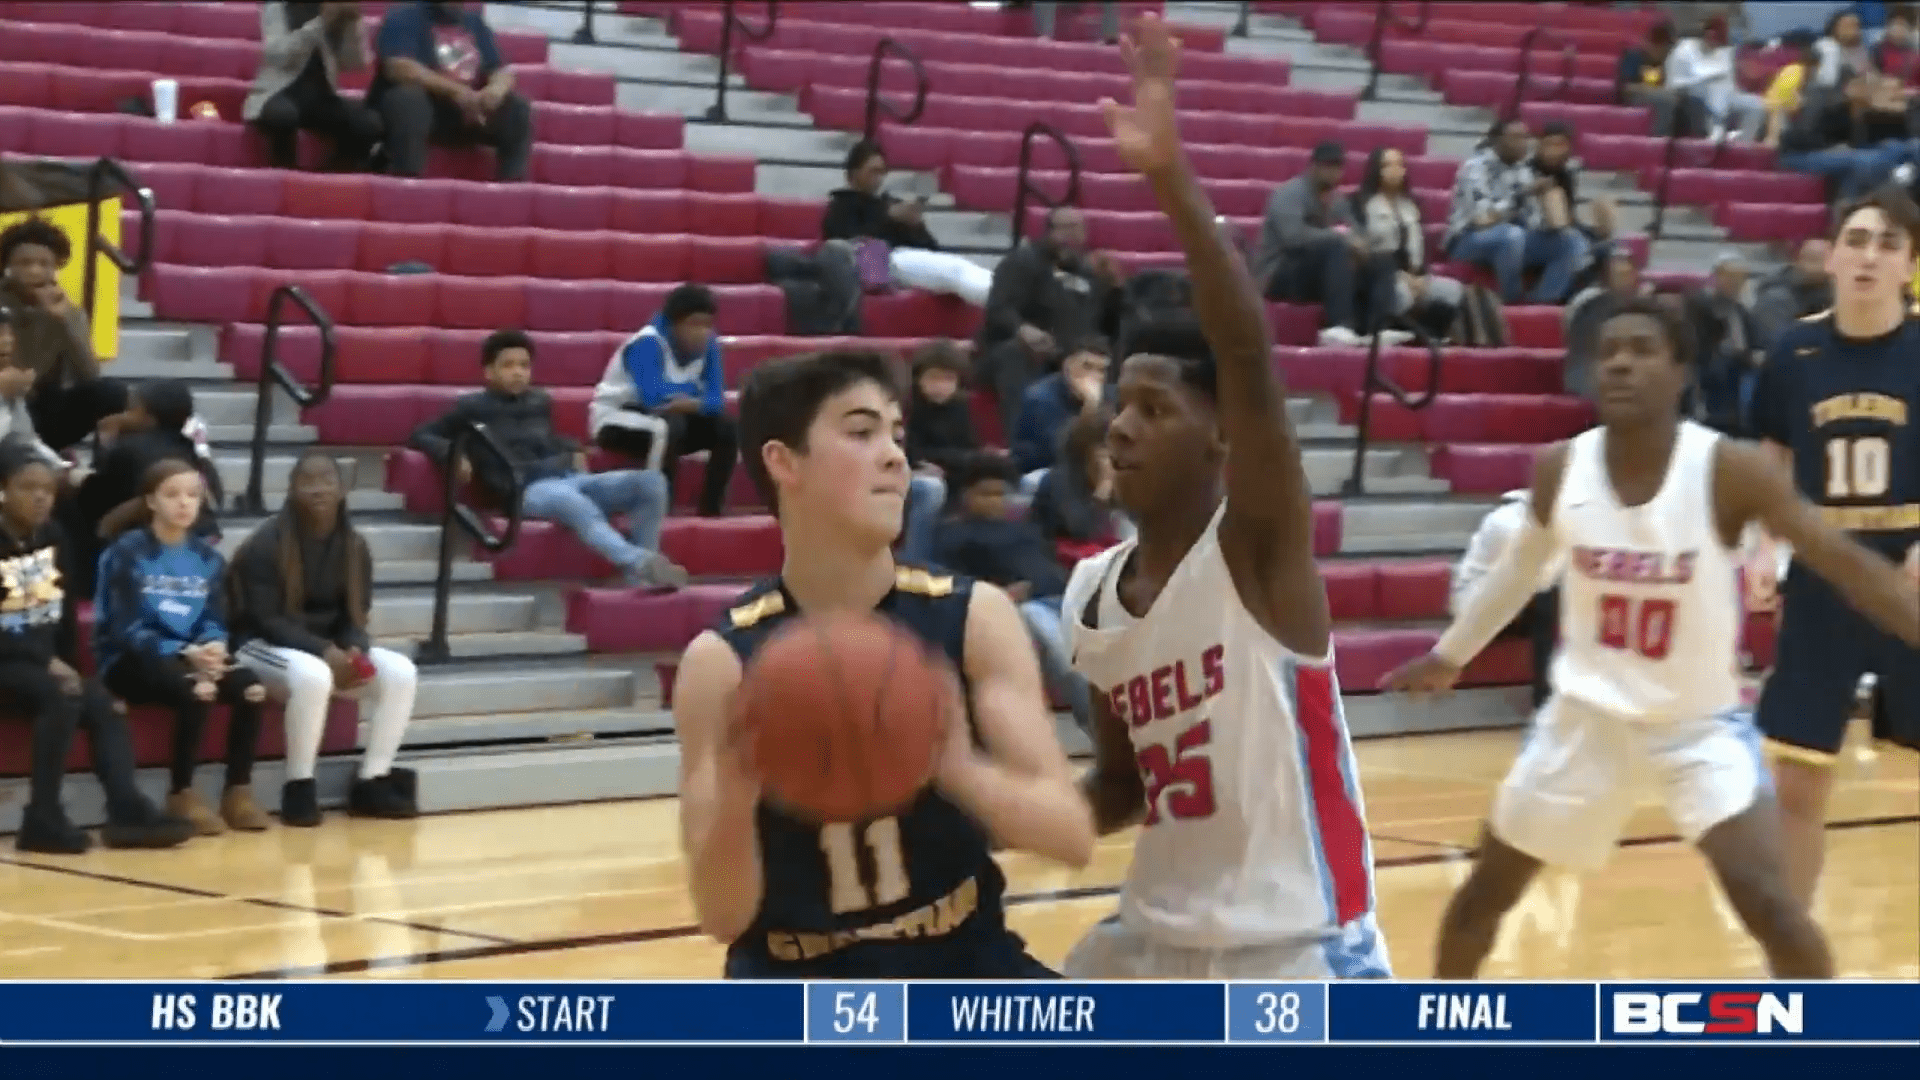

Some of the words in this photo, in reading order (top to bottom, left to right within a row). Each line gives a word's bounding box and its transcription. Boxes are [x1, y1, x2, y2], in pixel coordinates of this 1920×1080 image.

[1826, 436, 1890, 498] 10
[1108, 644, 1225, 728] EBELS
[819, 815, 911, 915] 11
